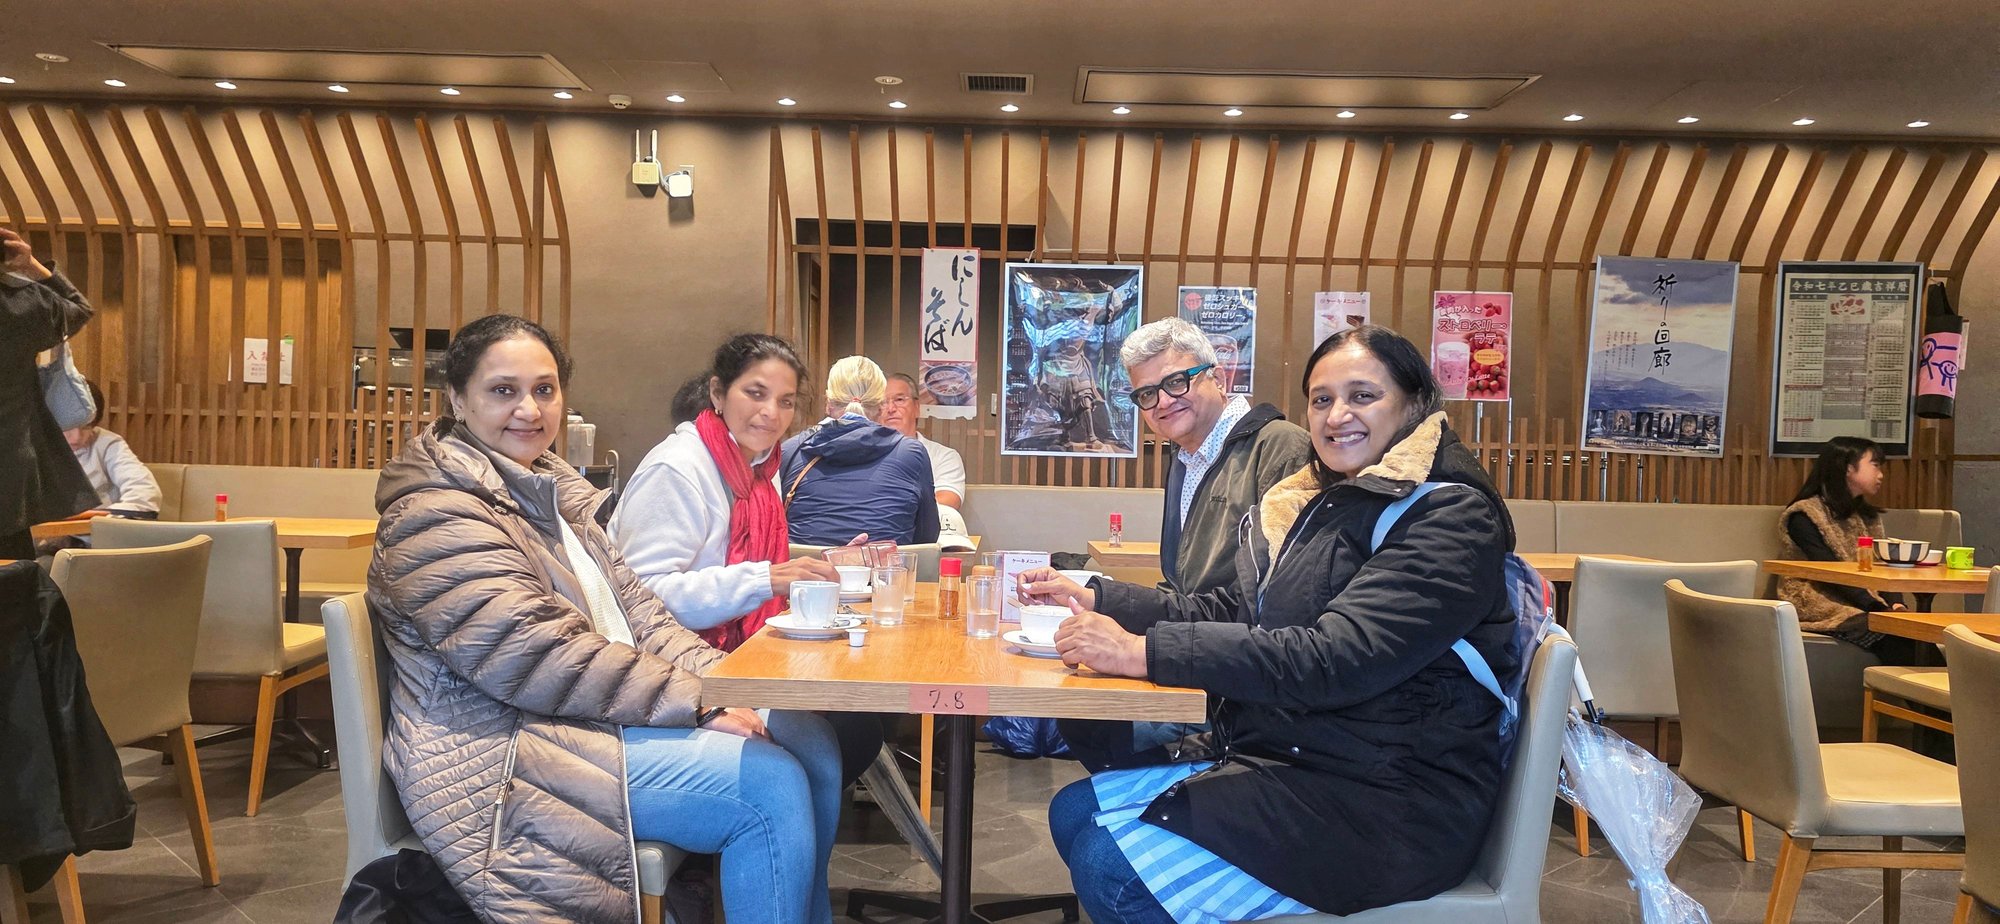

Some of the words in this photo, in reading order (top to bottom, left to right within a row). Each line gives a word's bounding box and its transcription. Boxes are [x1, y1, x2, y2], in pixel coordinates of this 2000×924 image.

[924, 286, 950, 353] そば
[951, 254, 976, 337] にしん
[1438, 319, 1507, 331] ストロベリー
[1648, 273, 1678, 375] 祈りの回廊
[1474, 332, 1497, 345] ラテ
